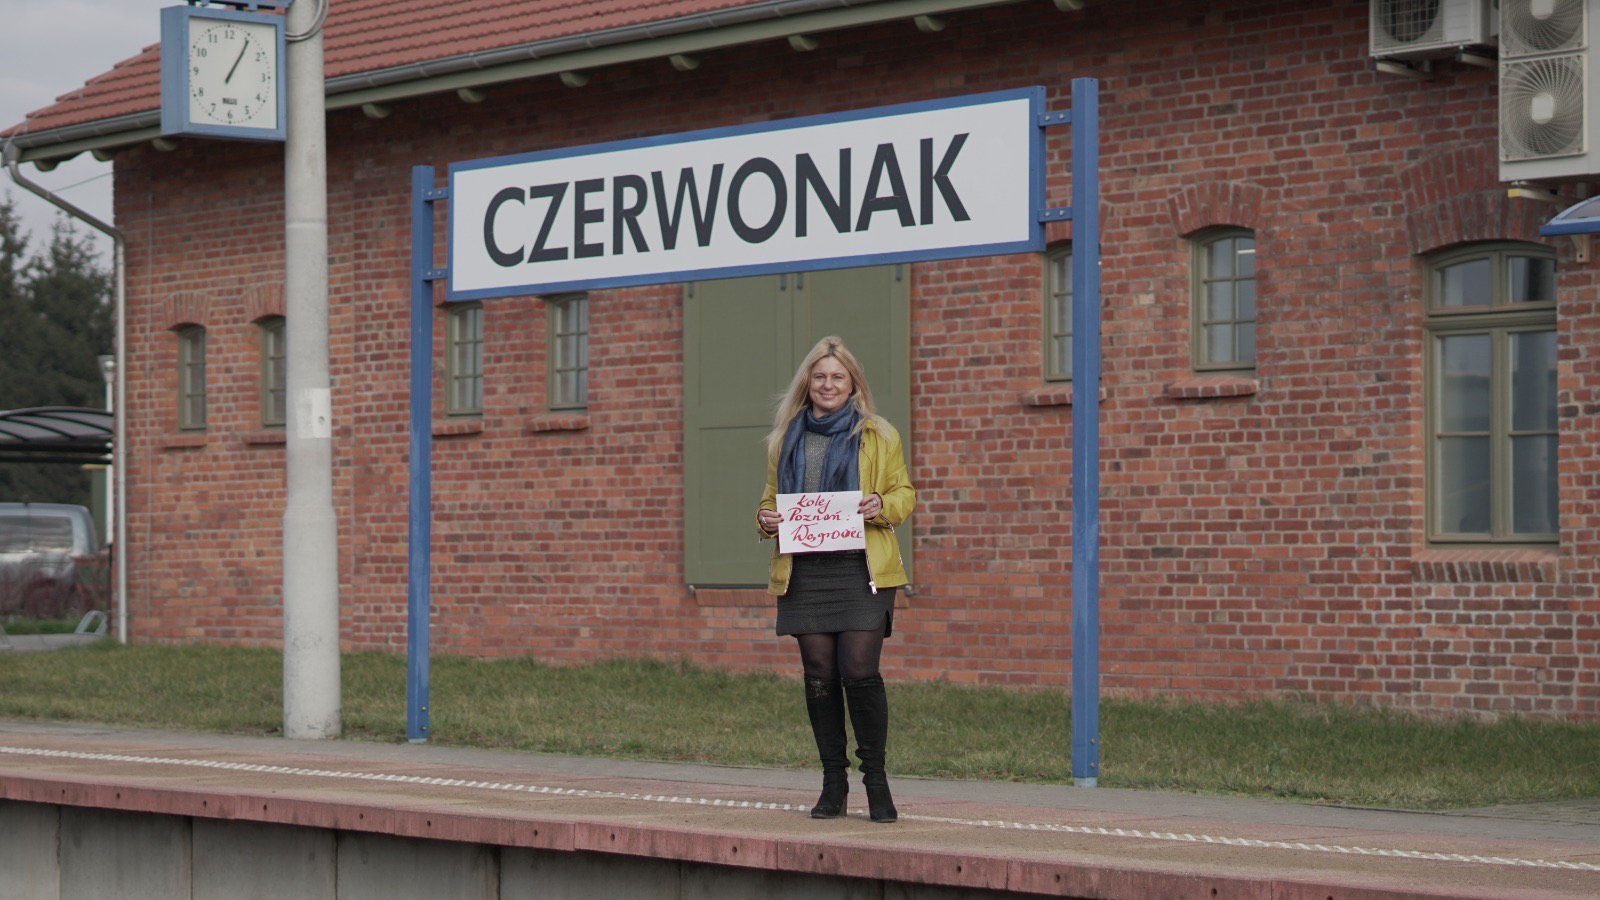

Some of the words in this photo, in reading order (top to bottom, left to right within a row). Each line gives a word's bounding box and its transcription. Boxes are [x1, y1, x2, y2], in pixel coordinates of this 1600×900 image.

[208, 33, 218, 43] 11
[224, 30, 235, 39] 12
[196, 48, 207, 57] 10
[255, 52, 261, 62] 2
[193, 66, 199, 75] 9
[261, 73, 266, 82] 3
[198, 87, 204, 97] 8
[256, 93, 261, 101] 4
[211, 102, 216, 112] 7
[245, 105, 250, 115] 5
[227, 110, 233, 119] 6
[483, 132, 971, 267] CZERWONAK
